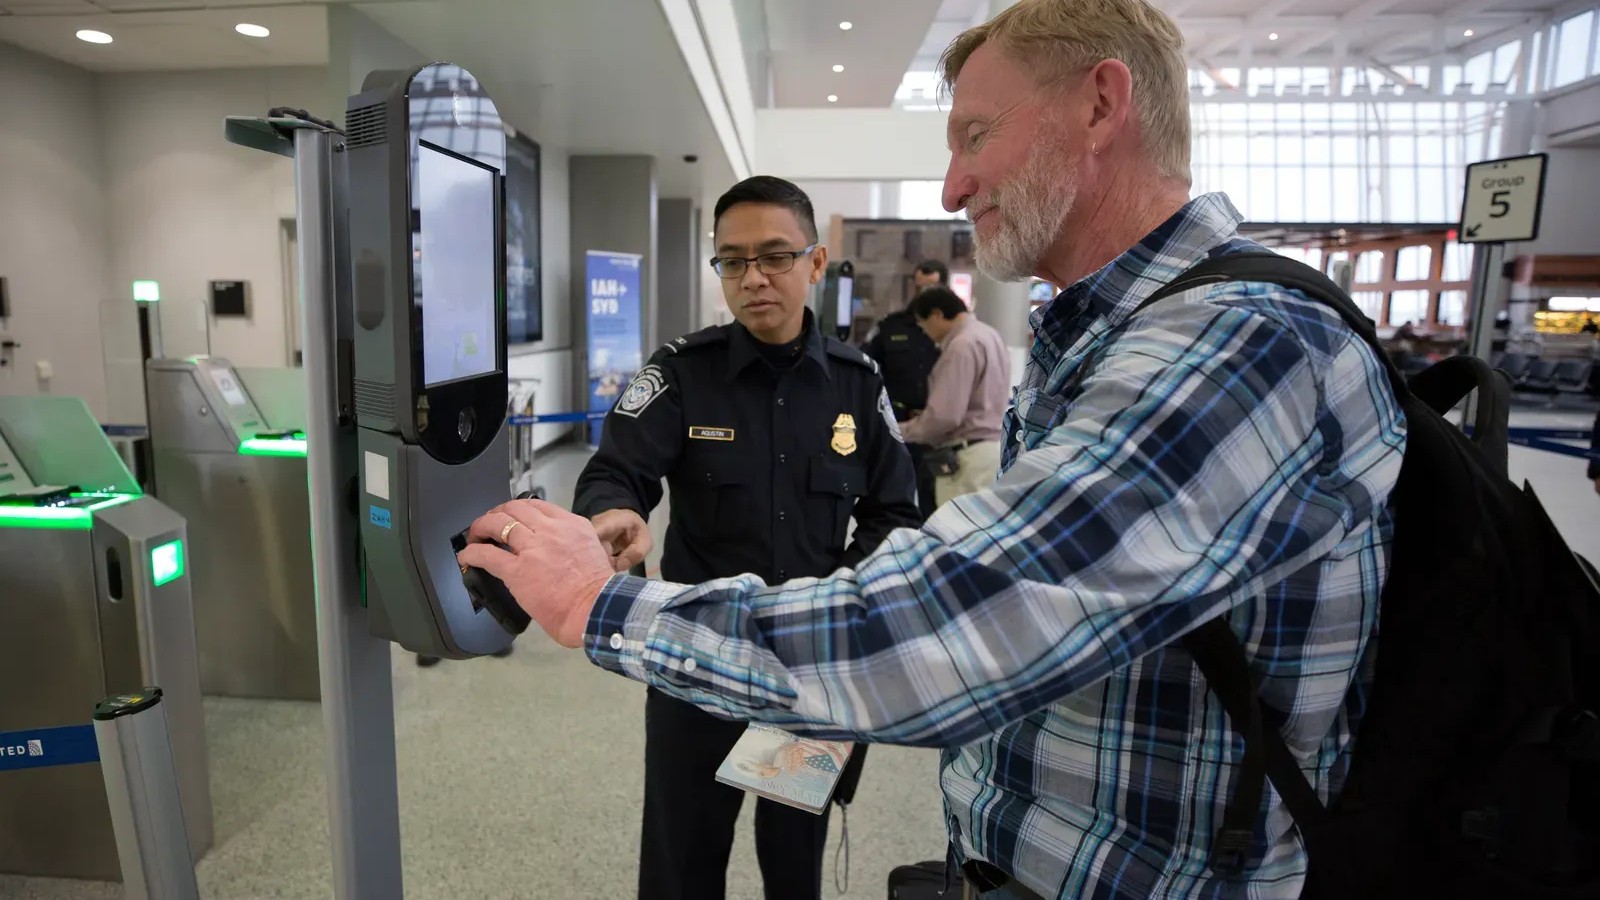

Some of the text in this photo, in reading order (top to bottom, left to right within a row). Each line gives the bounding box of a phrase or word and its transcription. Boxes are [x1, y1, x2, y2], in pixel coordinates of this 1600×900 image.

[1481, 175, 1525, 189] Group
[1489, 190, 1511, 218] 5
[591, 298, 619, 315] SYD
[700, 429, 725, 438] AGUSTIN
